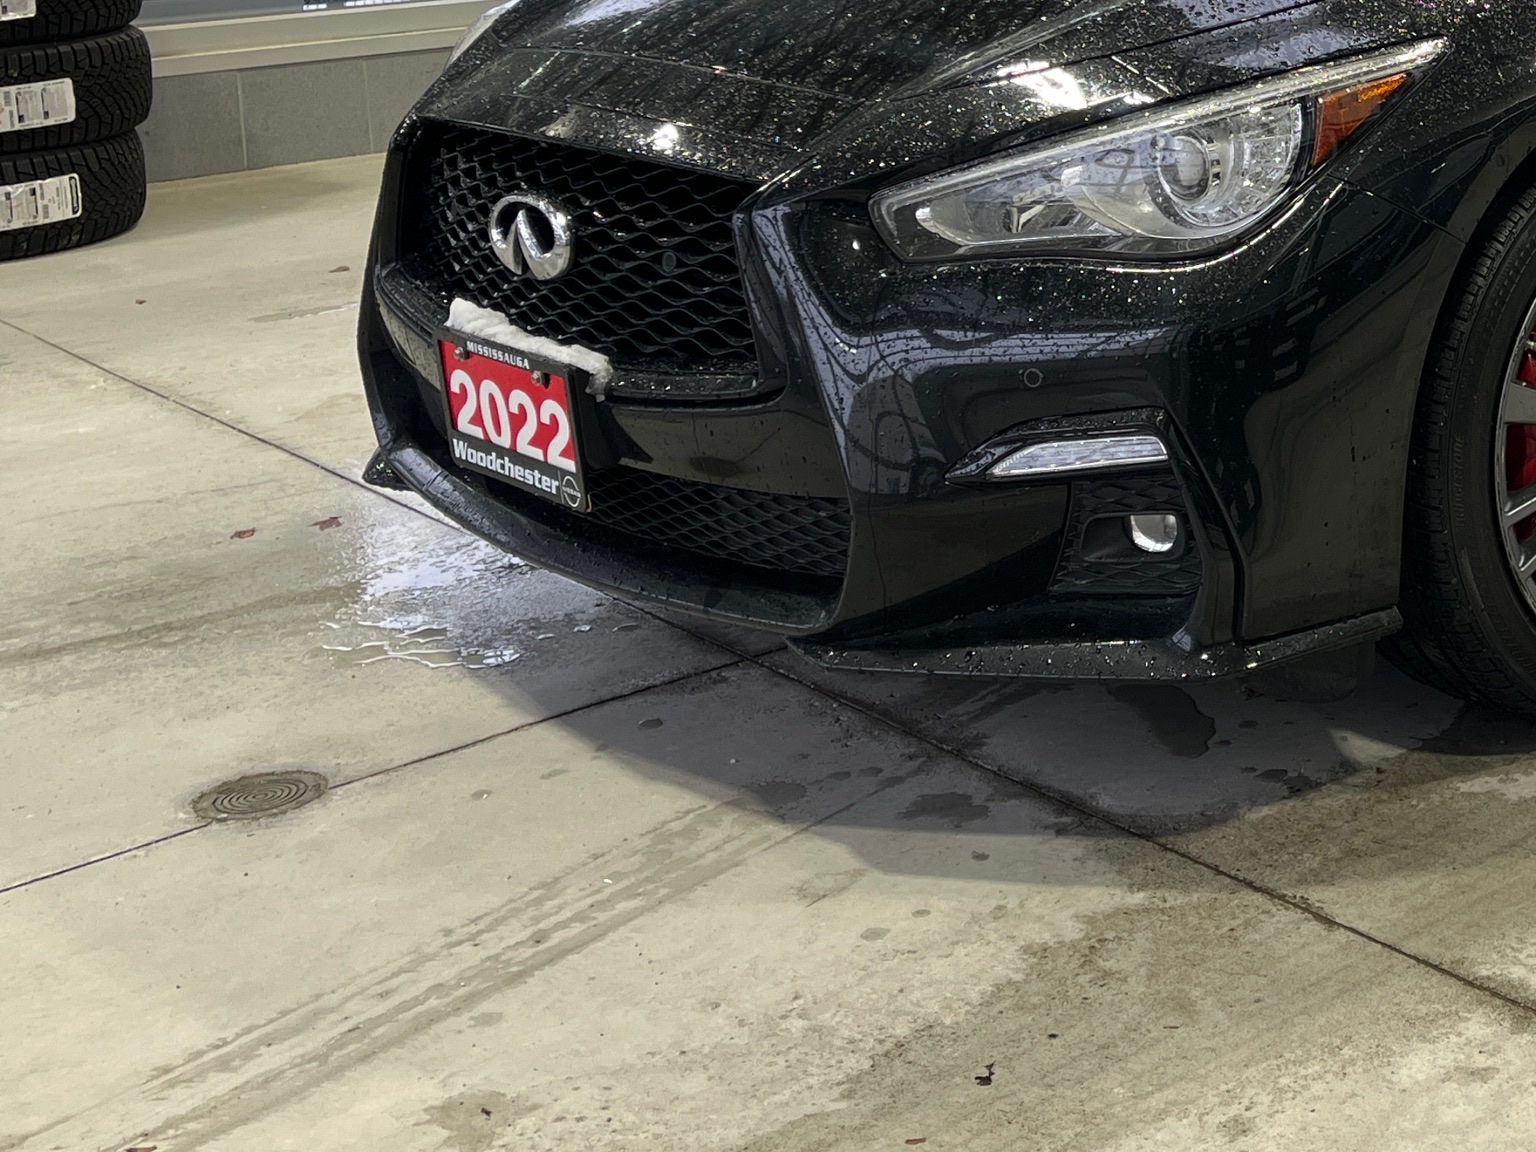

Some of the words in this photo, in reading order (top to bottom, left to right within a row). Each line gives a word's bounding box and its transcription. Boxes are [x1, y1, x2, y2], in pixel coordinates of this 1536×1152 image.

[466, 341, 530, 370] MISSISSAUGA
[450, 369, 577, 473] 2022
[452, 438, 559, 495] Woodchester
